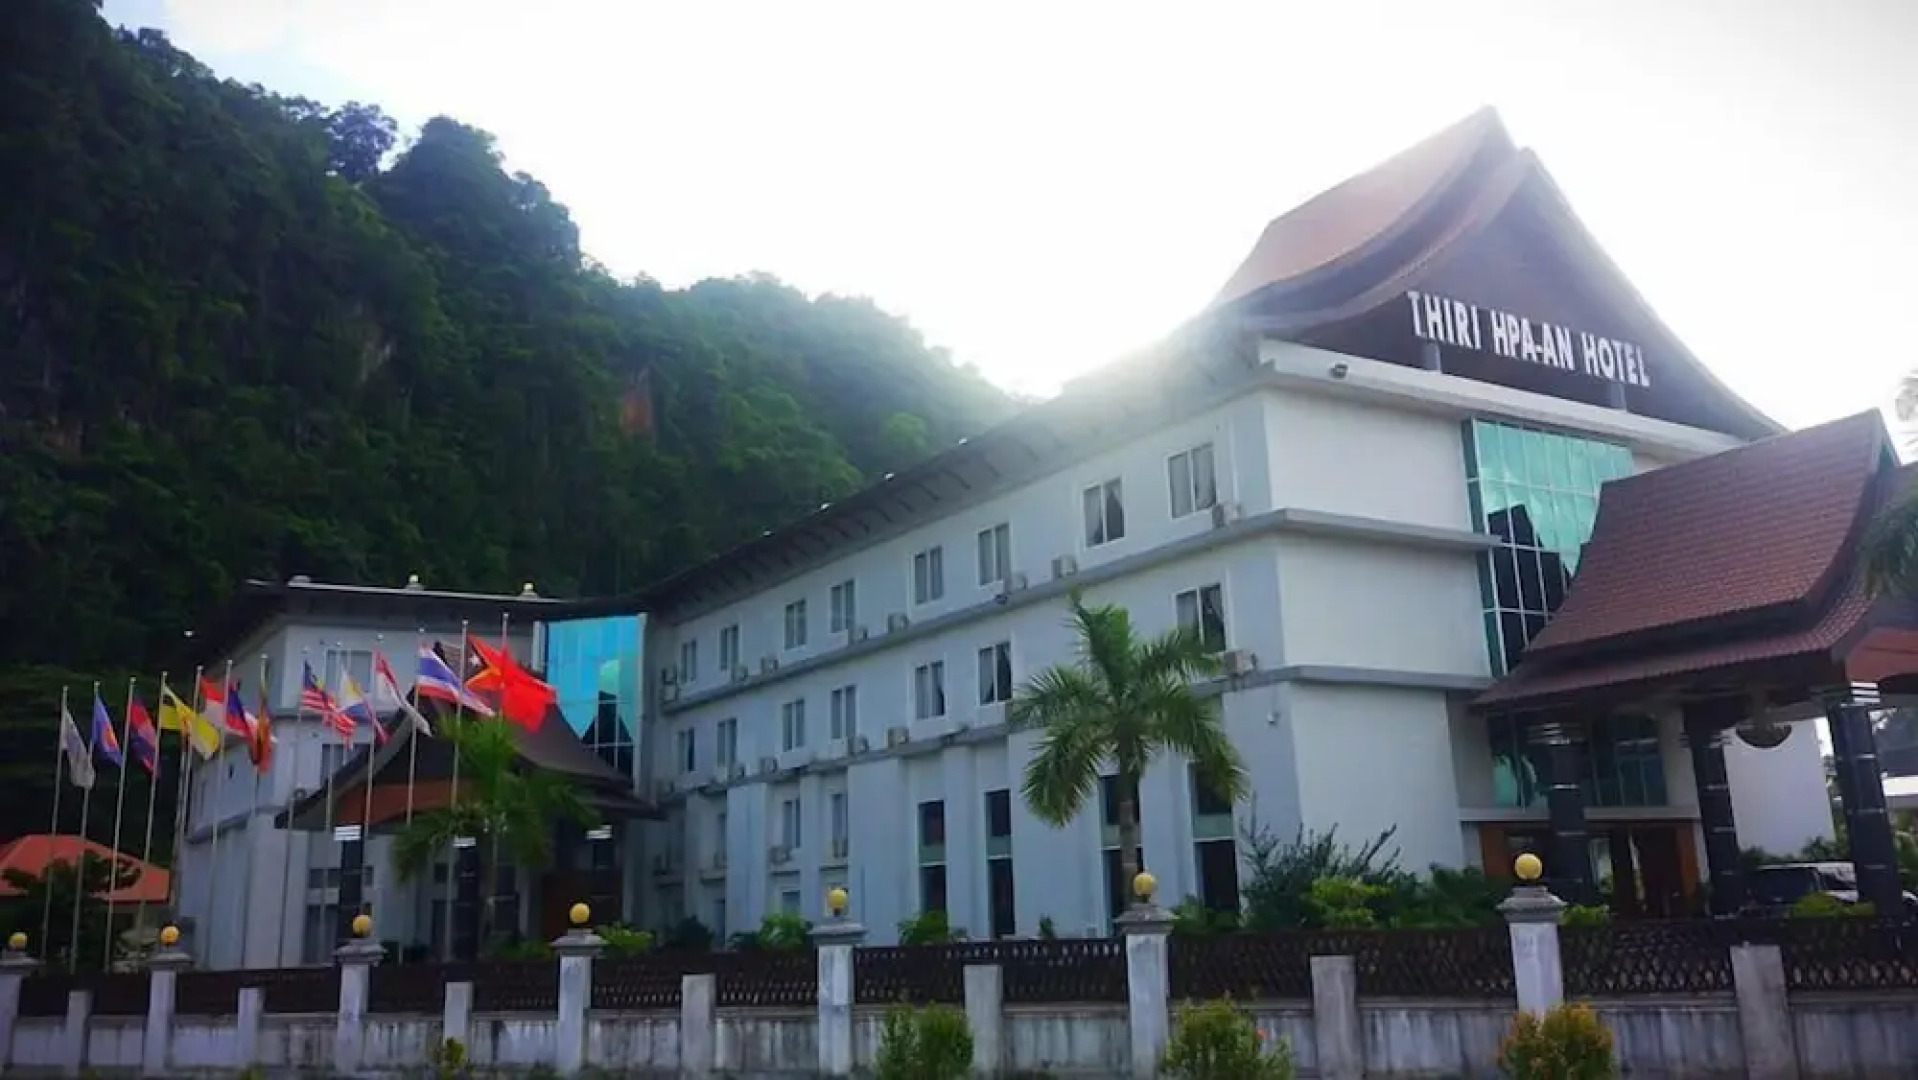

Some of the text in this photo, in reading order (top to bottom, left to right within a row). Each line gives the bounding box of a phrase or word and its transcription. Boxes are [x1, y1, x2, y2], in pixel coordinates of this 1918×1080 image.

[1407, 291, 1650, 387] THIRI HPA-AN HOTEL
